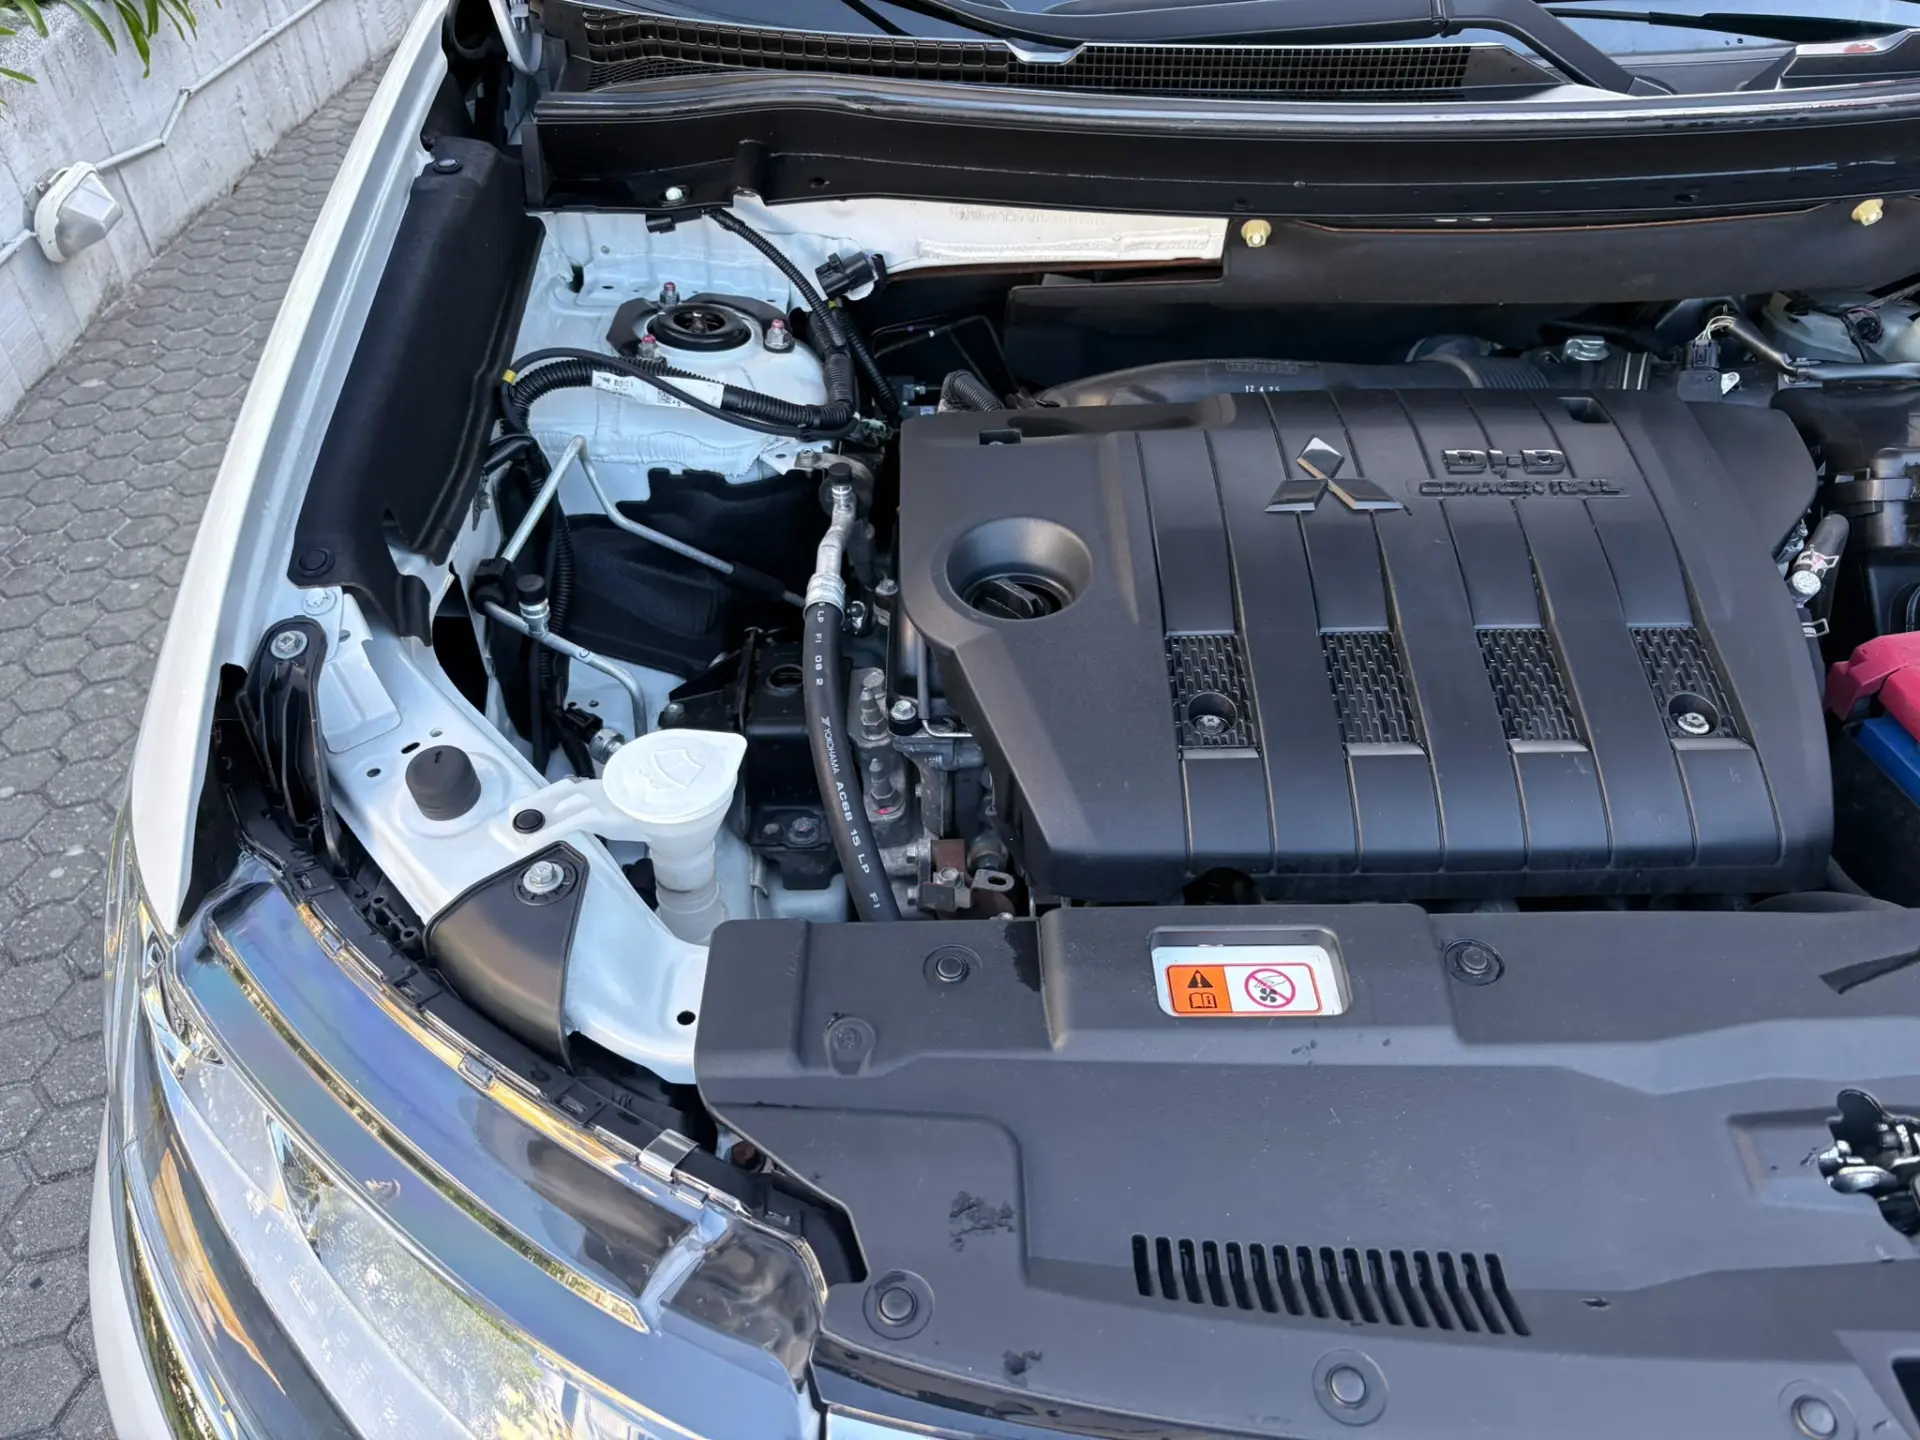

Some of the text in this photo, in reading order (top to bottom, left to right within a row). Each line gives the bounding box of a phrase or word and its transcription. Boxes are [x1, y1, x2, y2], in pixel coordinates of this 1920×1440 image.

[824, 727, 841, 775] YOKOHAMA
[850, 828, 862, 847] 15
[858, 853, 870, 874] LP
